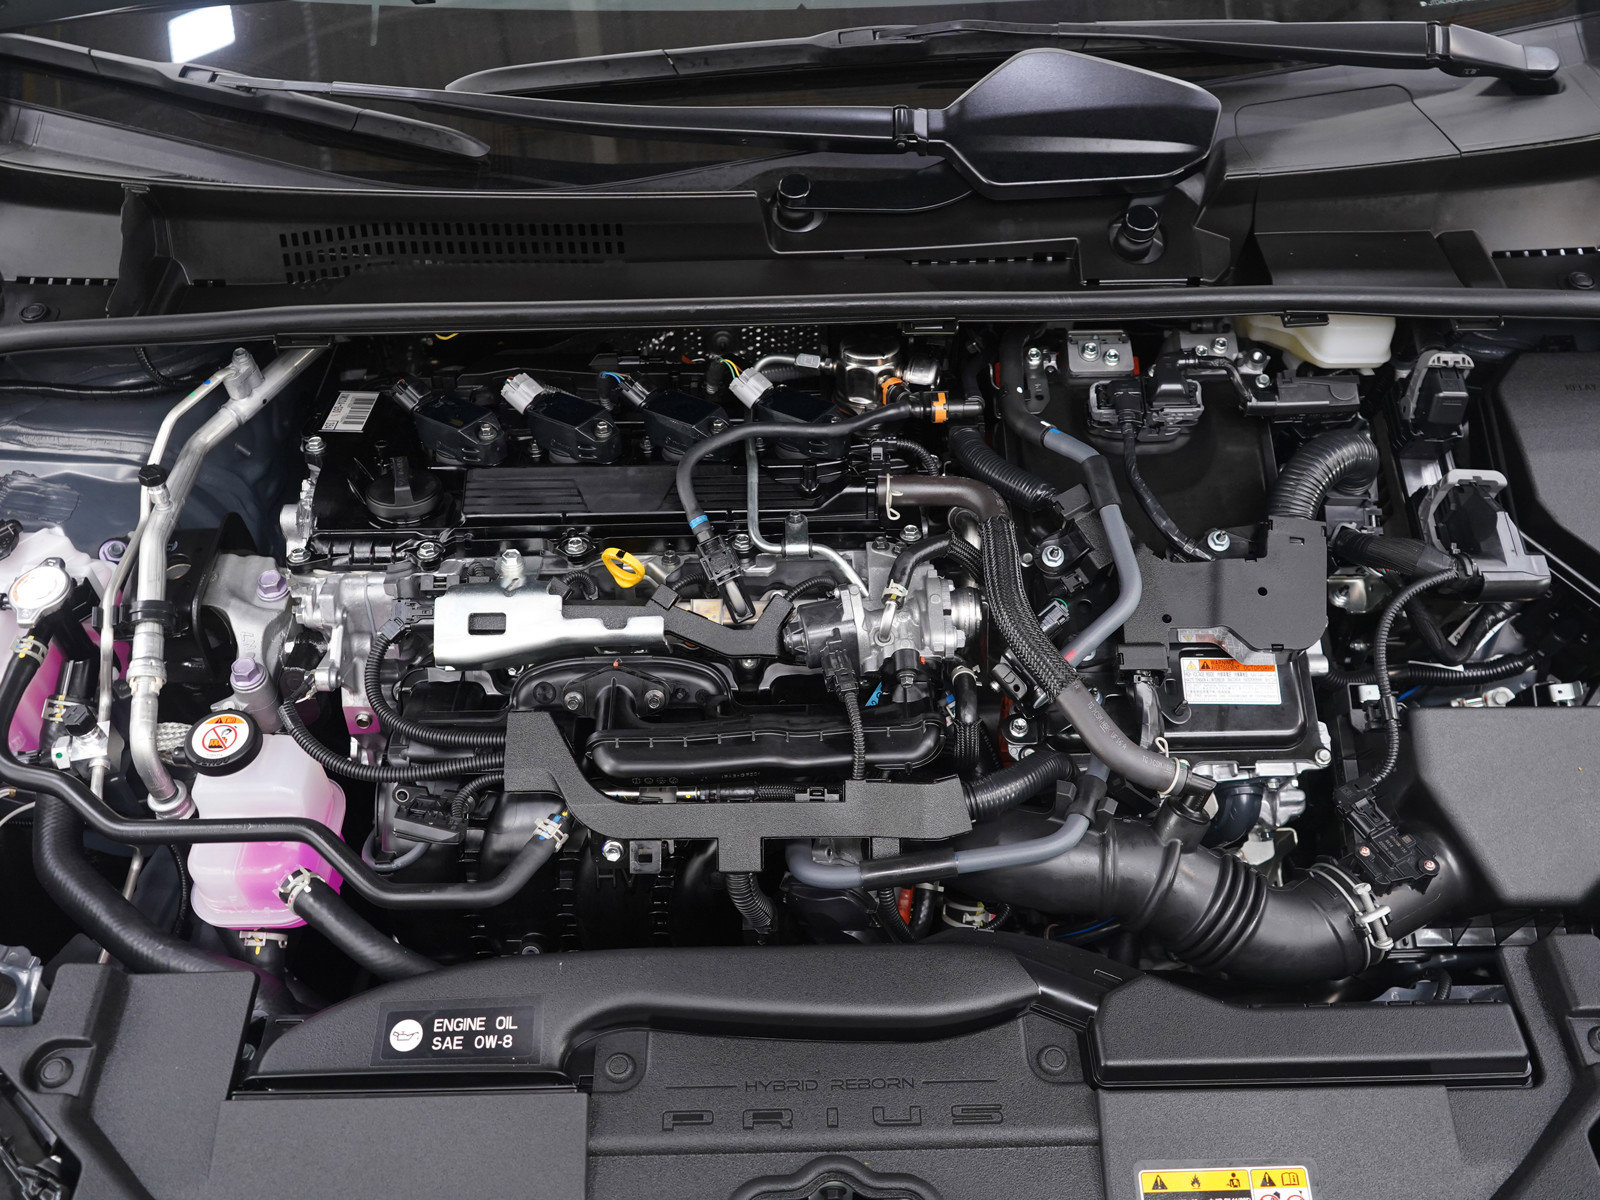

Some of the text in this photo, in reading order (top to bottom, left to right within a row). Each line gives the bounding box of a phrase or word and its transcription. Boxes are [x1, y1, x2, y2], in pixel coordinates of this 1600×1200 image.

[433, 1015, 518, 1032] ENGINE OIL
[431, 1034, 513, 1051] SAE 0W-8
[745, 1077, 915, 1092] HYBRID REBORN
[661, 1103, 1003, 1132] PRIUS
